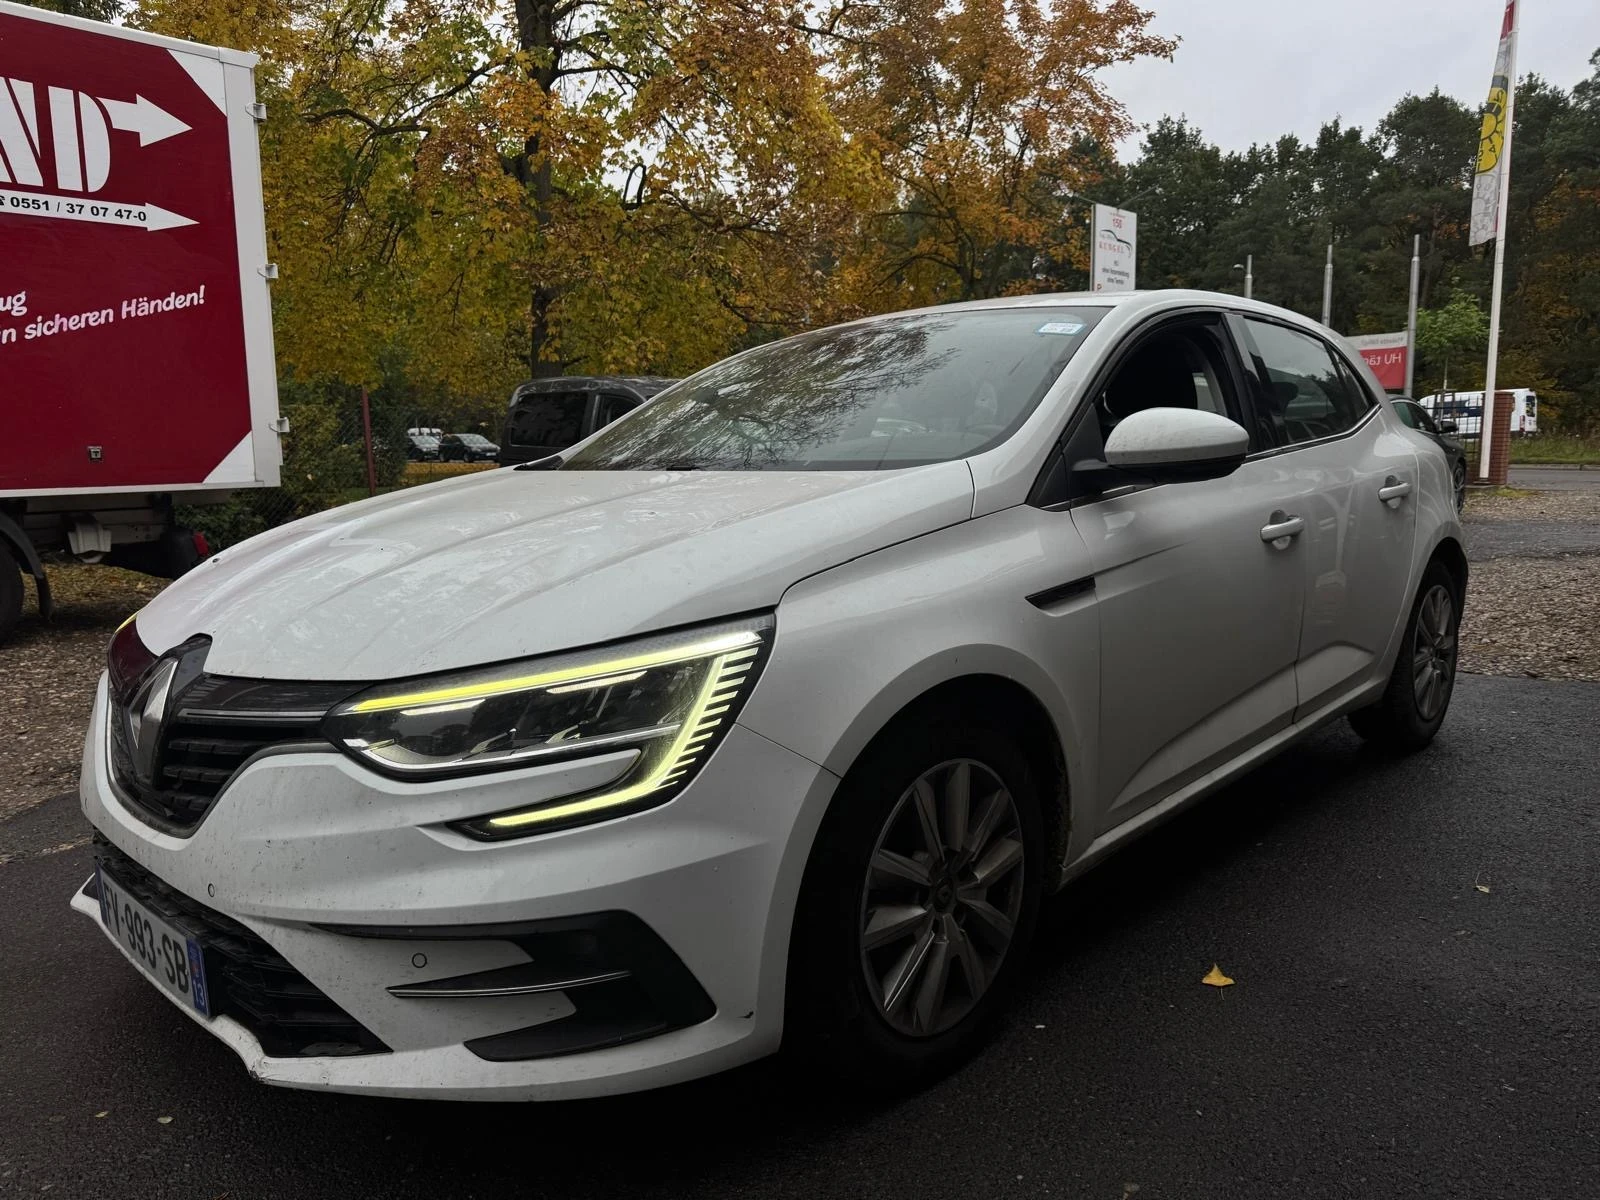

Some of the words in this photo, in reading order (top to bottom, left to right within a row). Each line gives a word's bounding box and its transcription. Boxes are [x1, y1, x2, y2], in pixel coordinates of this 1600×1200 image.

[10, 197, 50, 211] 0551
[57, 202, 61, 213] /
[66, 203, 85, 215] 37
[90, 206, 109, 218] 07
[114, 209, 147, 222] 47-0
[24, 306, 114, 340] sicheren
[121, 285, 206, 320] Händen!
[102, 882, 189, 994] FV-993-SB
